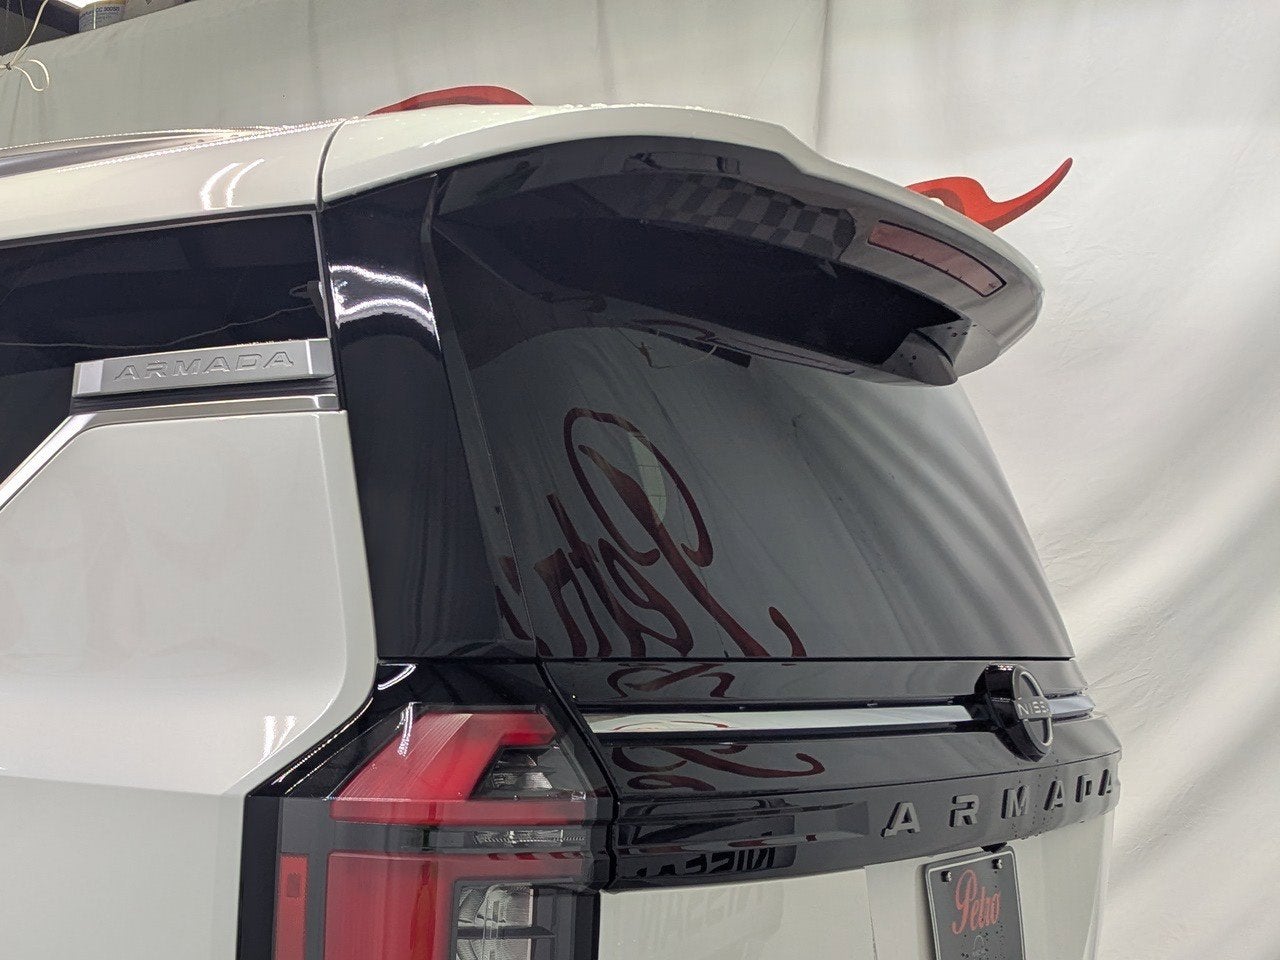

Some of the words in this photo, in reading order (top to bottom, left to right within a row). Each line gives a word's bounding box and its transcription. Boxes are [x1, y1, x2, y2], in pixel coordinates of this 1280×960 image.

[113, 351, 295, 382] ARMADA
[1017, 701, 1050, 716] NISS
[880, 768, 1113, 838] ARMADA
[951, 868, 1002, 935] Petro
